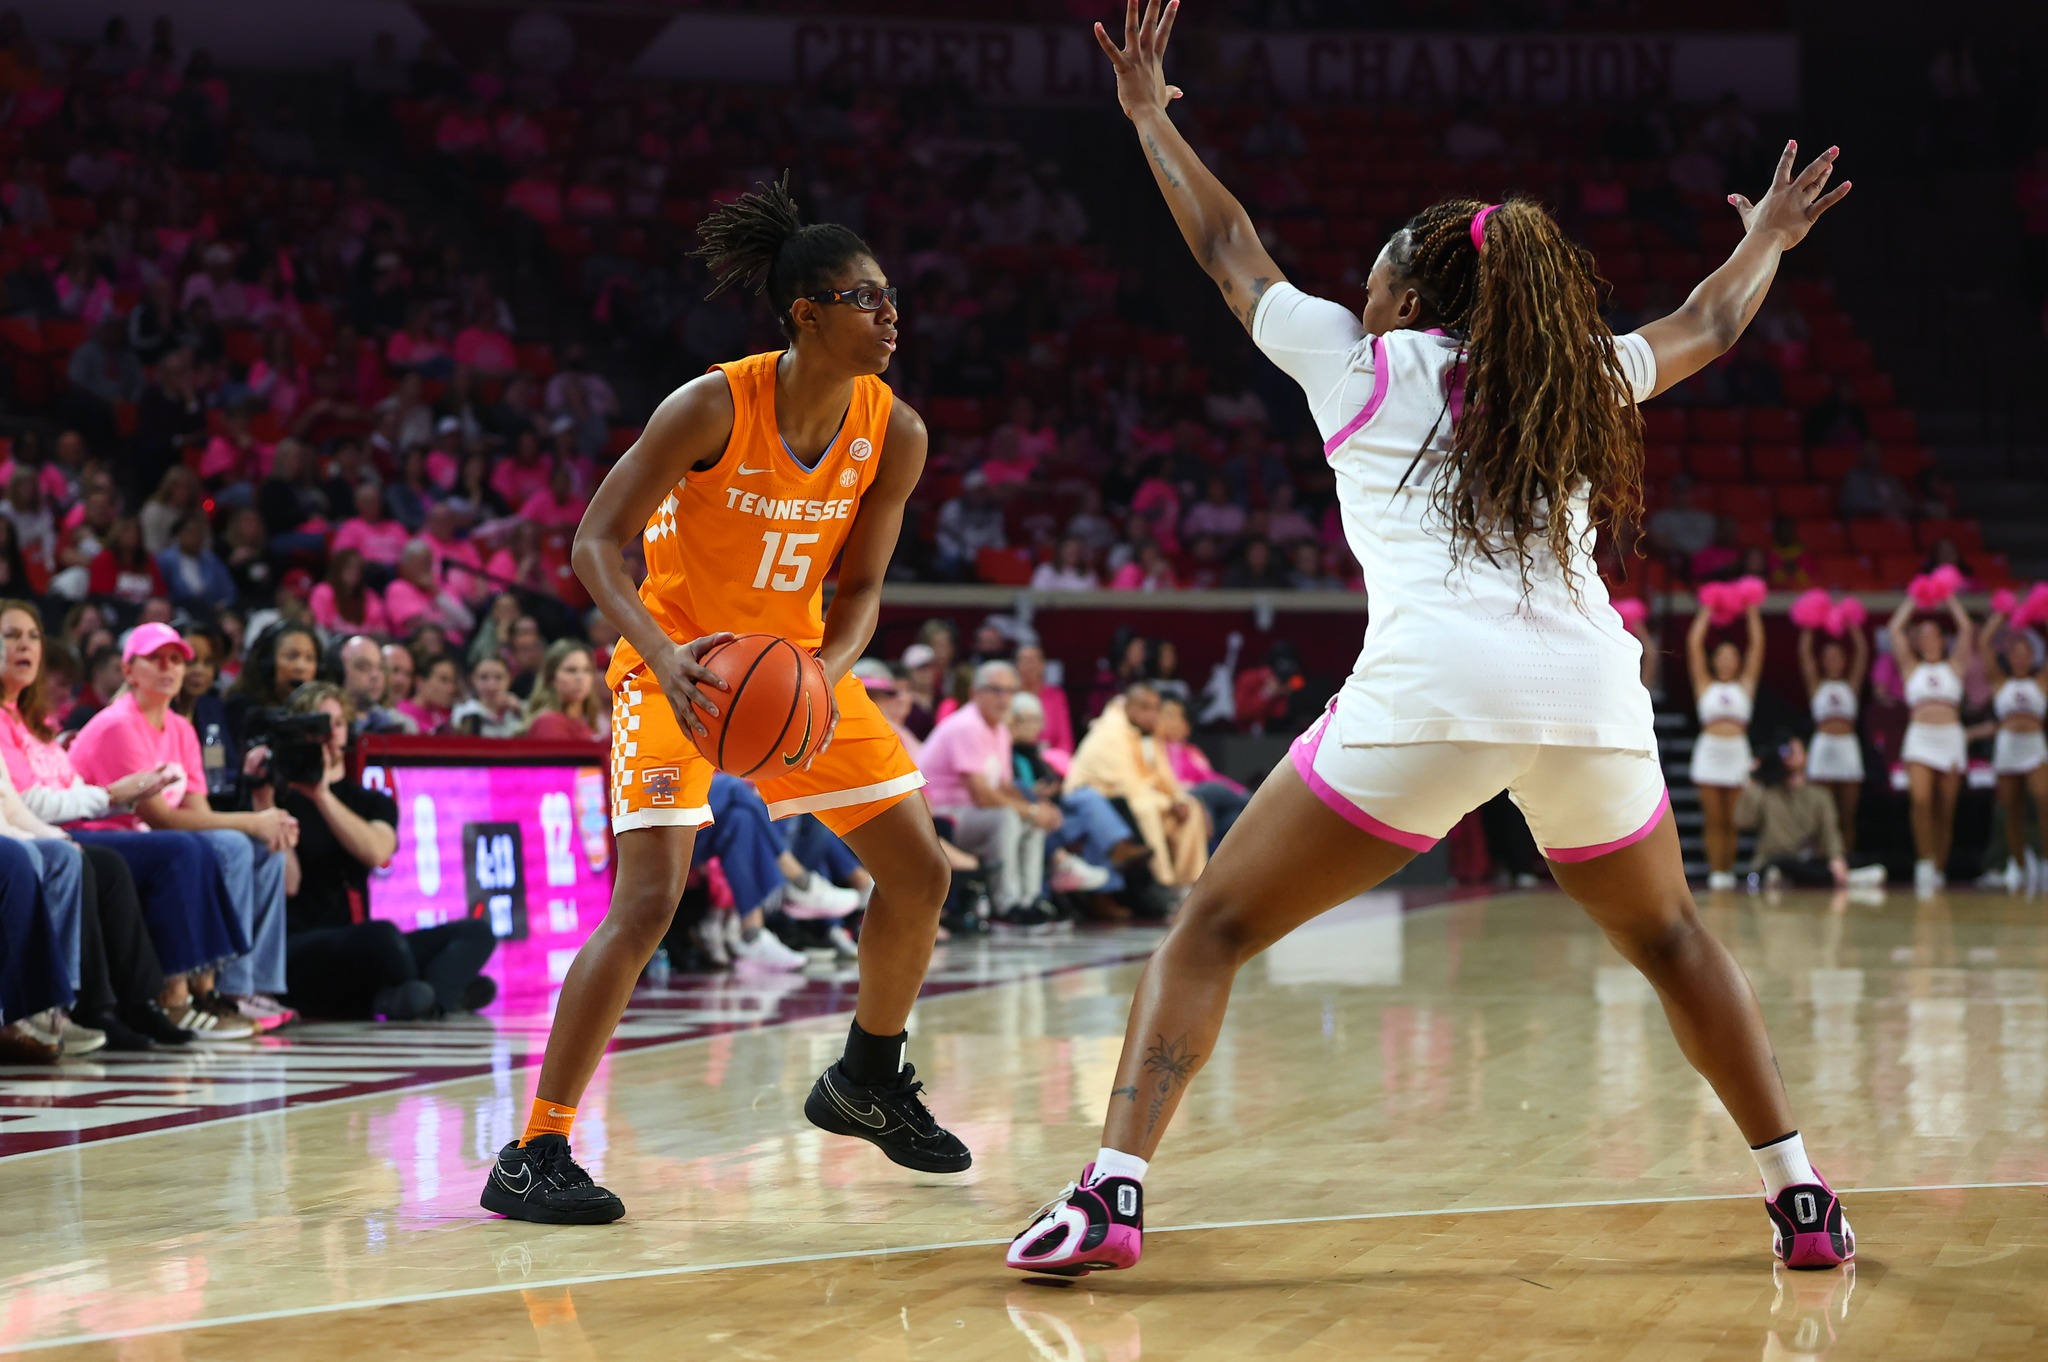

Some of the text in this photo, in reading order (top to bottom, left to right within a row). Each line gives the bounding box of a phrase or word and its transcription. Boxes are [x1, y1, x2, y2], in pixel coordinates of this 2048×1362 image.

[792, 24, 1014, 95] CHEER
[1239, 36, 1281, 100] A
[1306, 36, 1675, 101] CHAMPION
[726, 487, 856, 522] TENNESSE
[752, 531, 820, 592] 15
[1117, 1183, 1137, 1217] 0
[1794, 1191, 1818, 1225] 0
